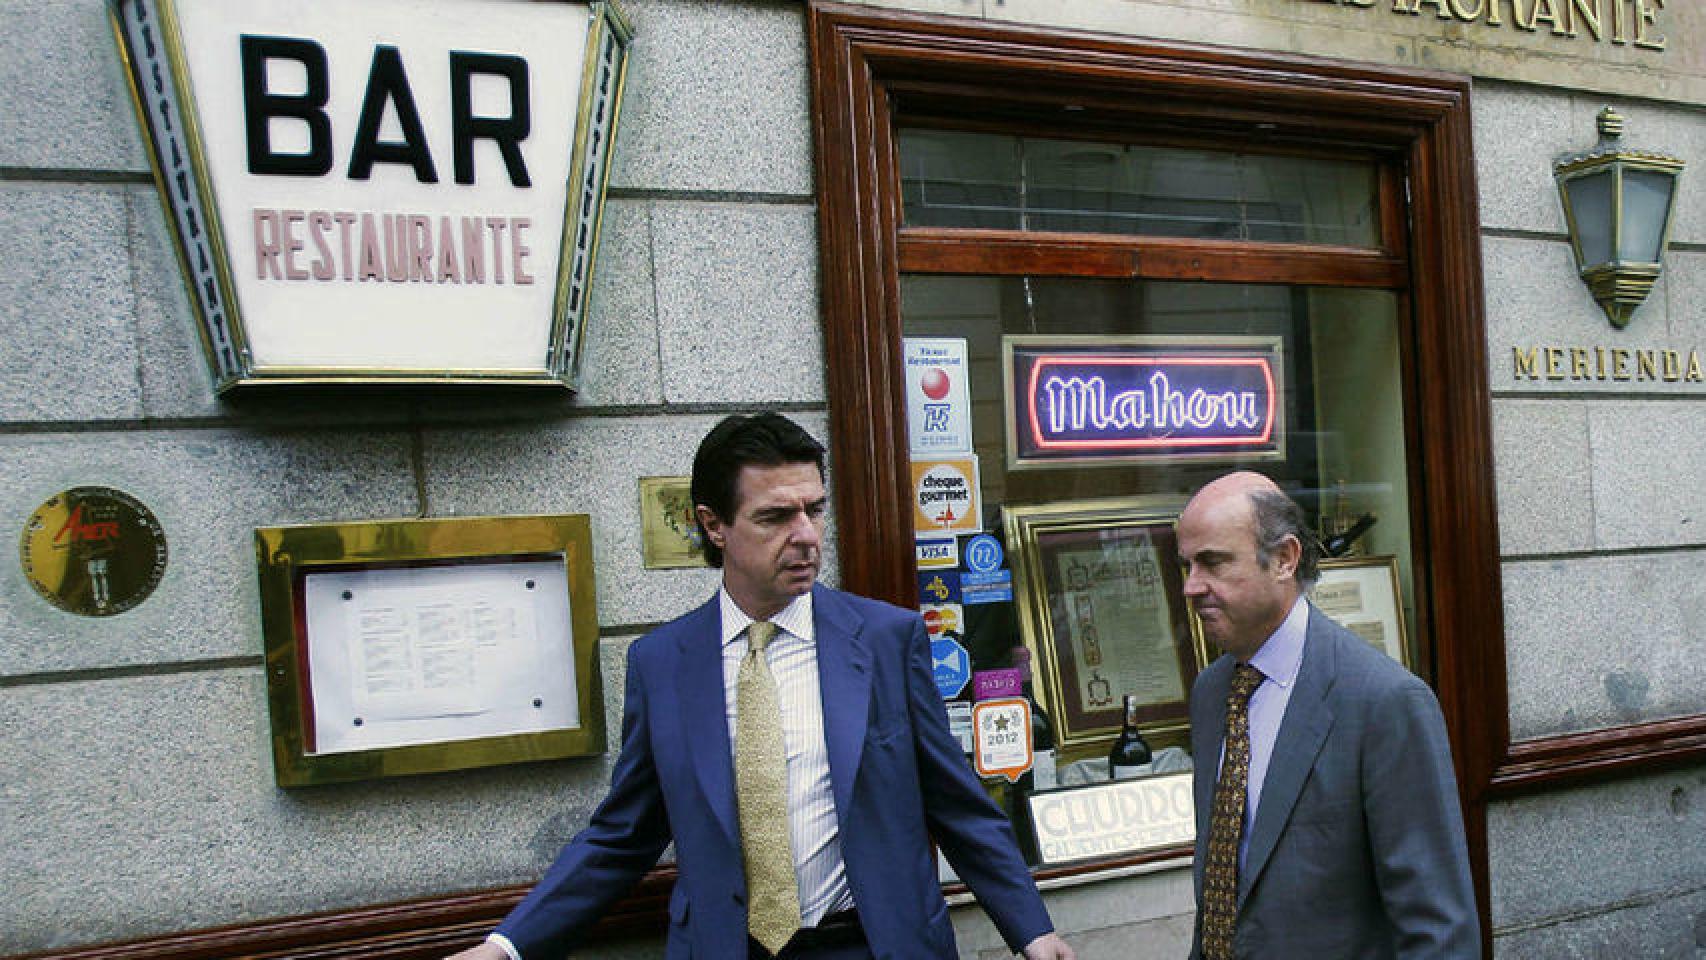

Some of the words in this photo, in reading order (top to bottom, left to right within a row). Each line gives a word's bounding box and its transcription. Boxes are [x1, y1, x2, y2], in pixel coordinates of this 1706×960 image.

[239, 32, 533, 188] BAR
[252, 207, 535, 286] RESTAURANTE
[1512, 345, 1704, 383] MERIENDA
[1045, 369, 1260, 433] Mahou
[923, 474, 964, 490] cheque
[919, 488, 968, 505] gourmet
[921, 547, 949, 559] VISA
[987, 731, 1019, 746] 2012
